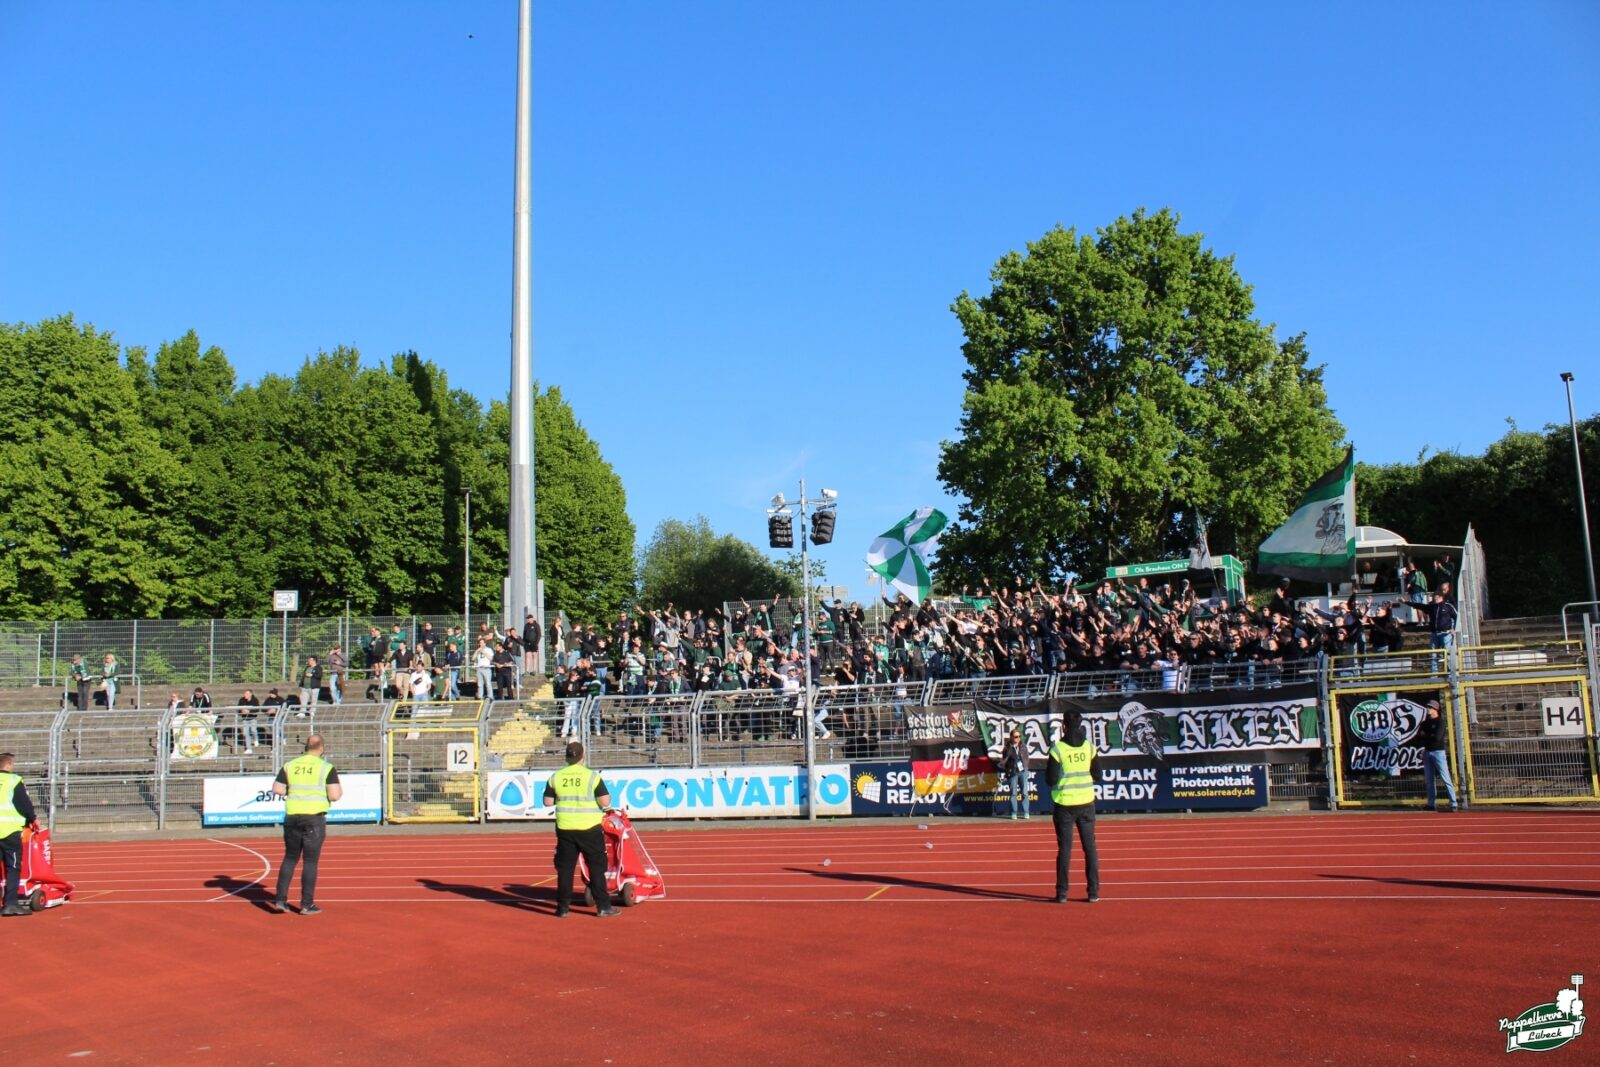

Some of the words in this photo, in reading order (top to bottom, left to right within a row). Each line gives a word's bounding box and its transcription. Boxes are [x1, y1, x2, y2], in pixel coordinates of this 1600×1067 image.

[1546, 706, 1583, 726] H4
[1068, 752, 1086, 763] 150
[294, 766, 313, 775] 214
[1190, 764, 1234, 774] Partner
[562, 778, 581, 788] 218
[1172, 775, 1255, 788] Photovoltaik
[533, 774, 849, 809] PYGONVATRO
[1094, 783, 1158, 800] READY
[1173, 787, 1256, 798] www.solarready.de
